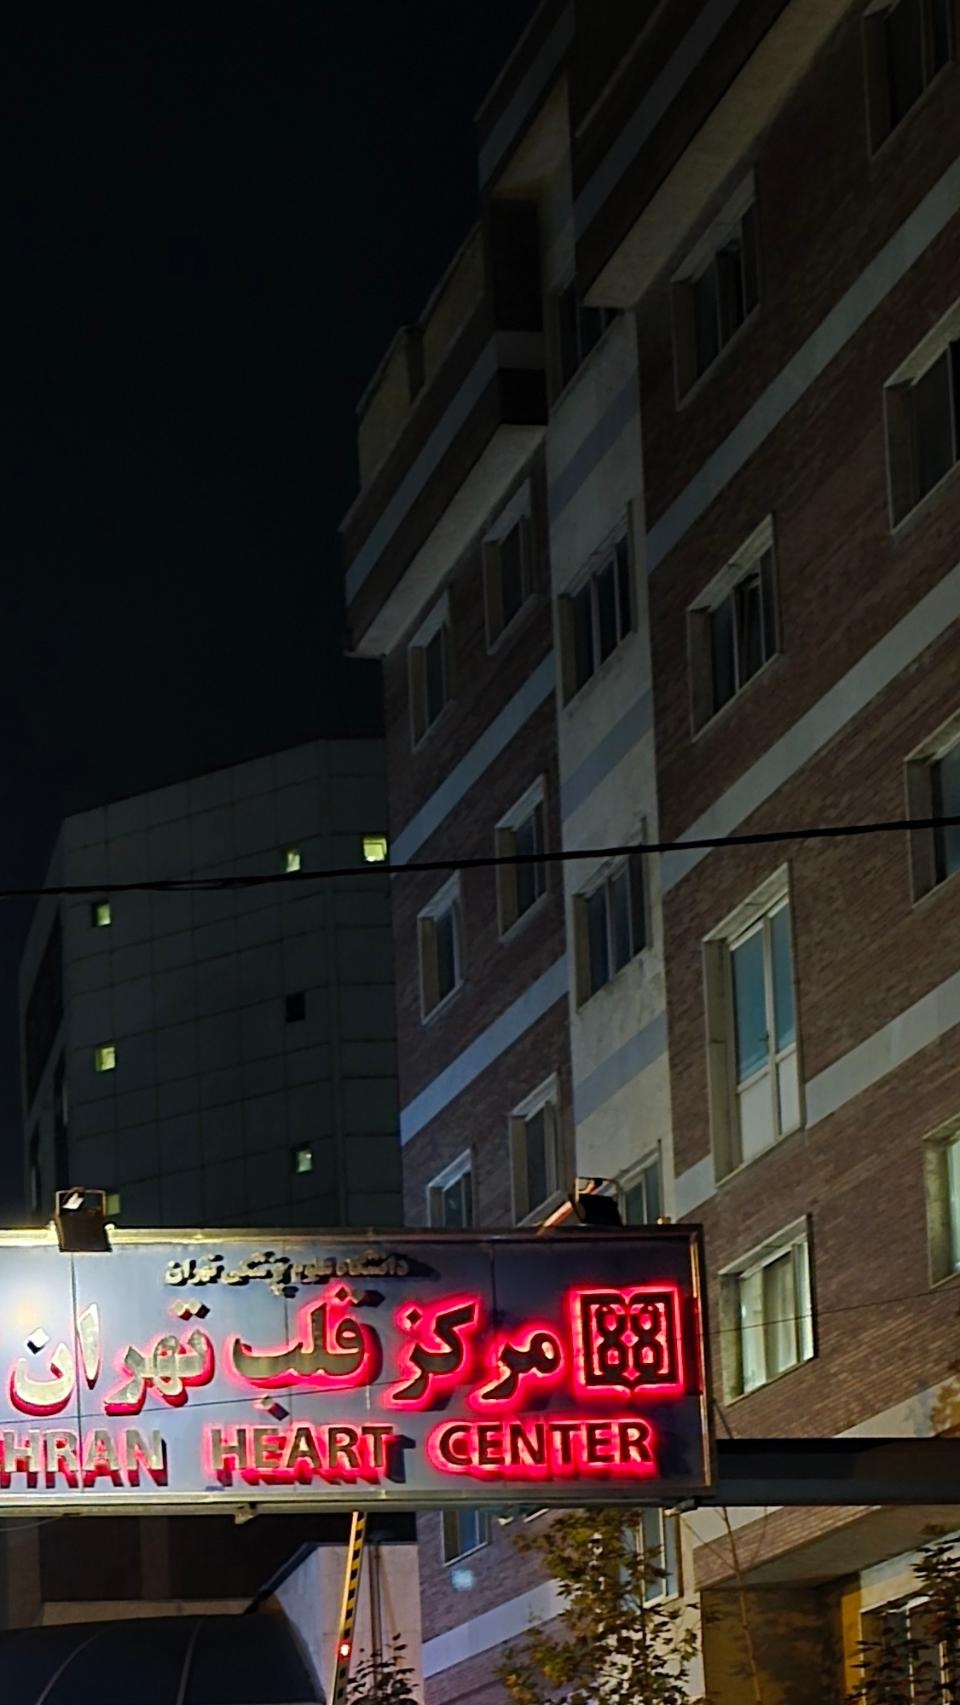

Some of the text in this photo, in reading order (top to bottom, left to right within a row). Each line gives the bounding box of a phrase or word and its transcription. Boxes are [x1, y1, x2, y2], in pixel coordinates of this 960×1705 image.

[165, 1253, 219, 1284] تهران
[13, 1287, 562, 1412] مرکز قلب تهران
[210, 1426, 395, 1470] HEART
[438, 1422, 653, 1467] CENTER
